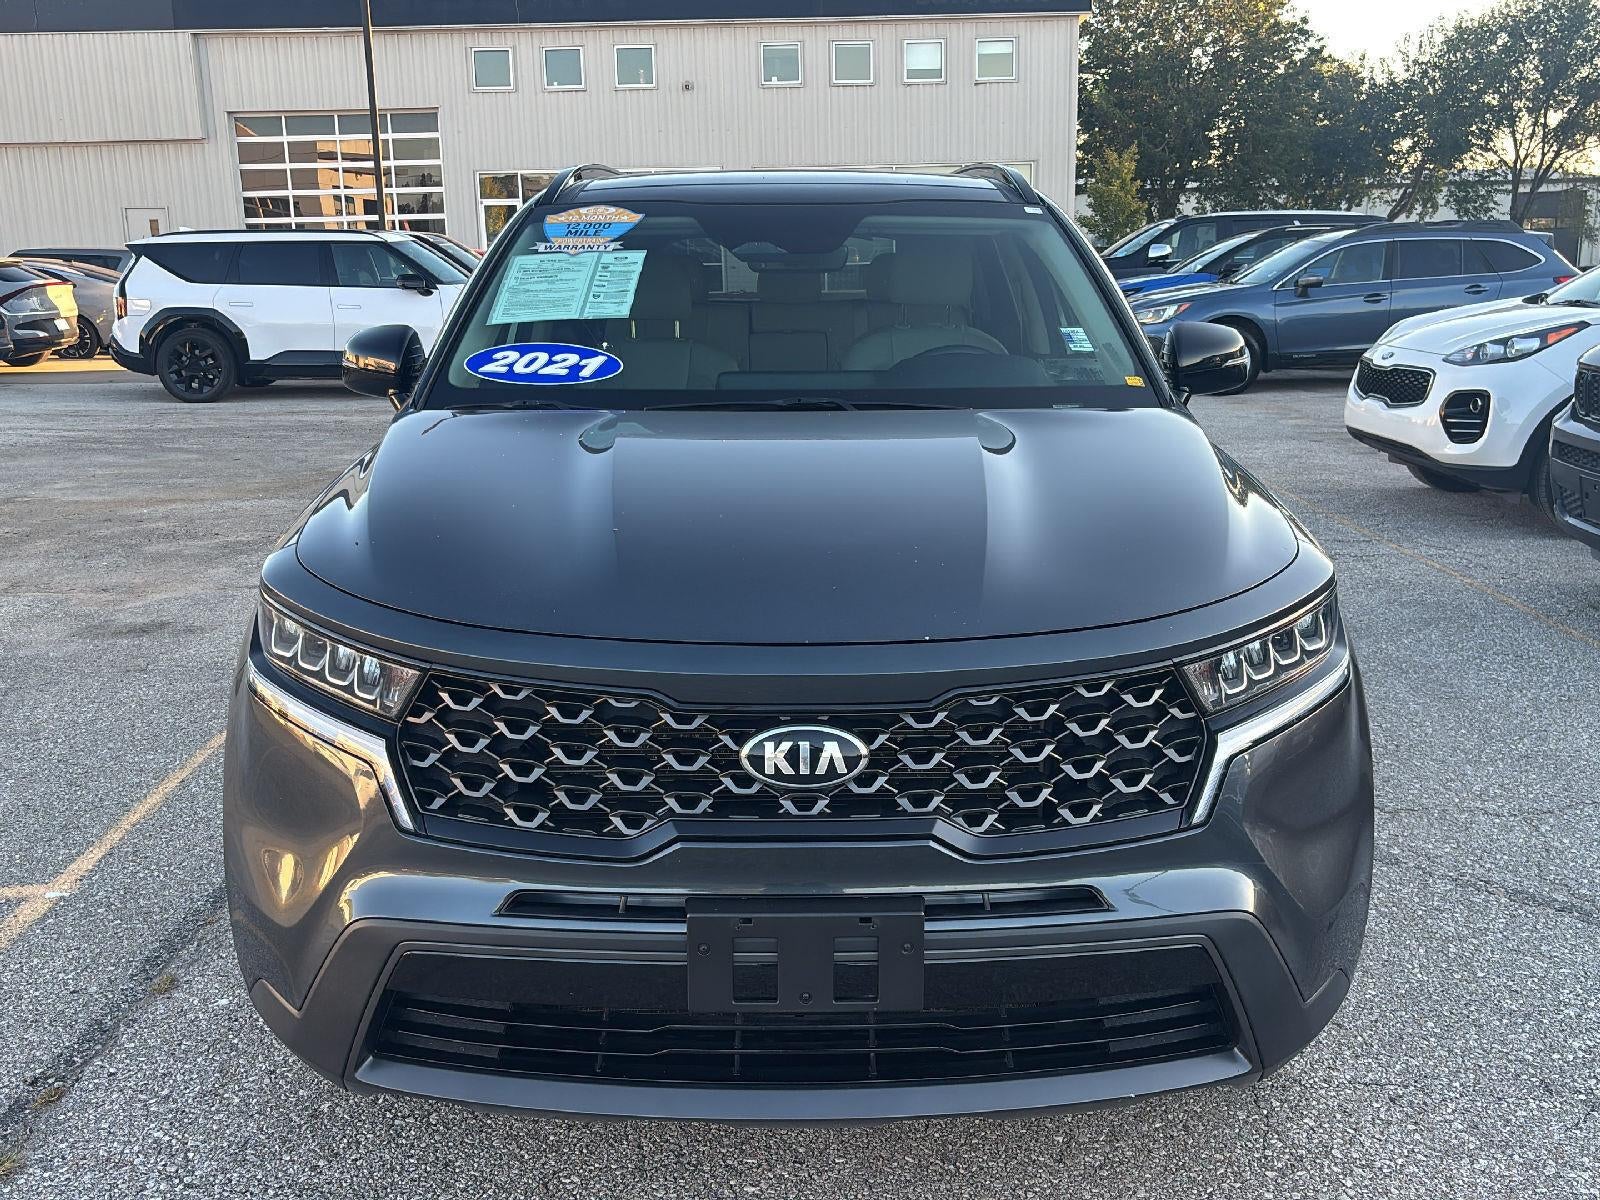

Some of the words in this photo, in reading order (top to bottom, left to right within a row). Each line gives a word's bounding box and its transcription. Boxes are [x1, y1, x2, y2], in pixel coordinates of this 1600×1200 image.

[565, 229, 602, 237] MILE
[566, 222, 611, 230] 12,000
[478, 350, 608, 378] 2021
[763, 741, 848, 775] KIA
